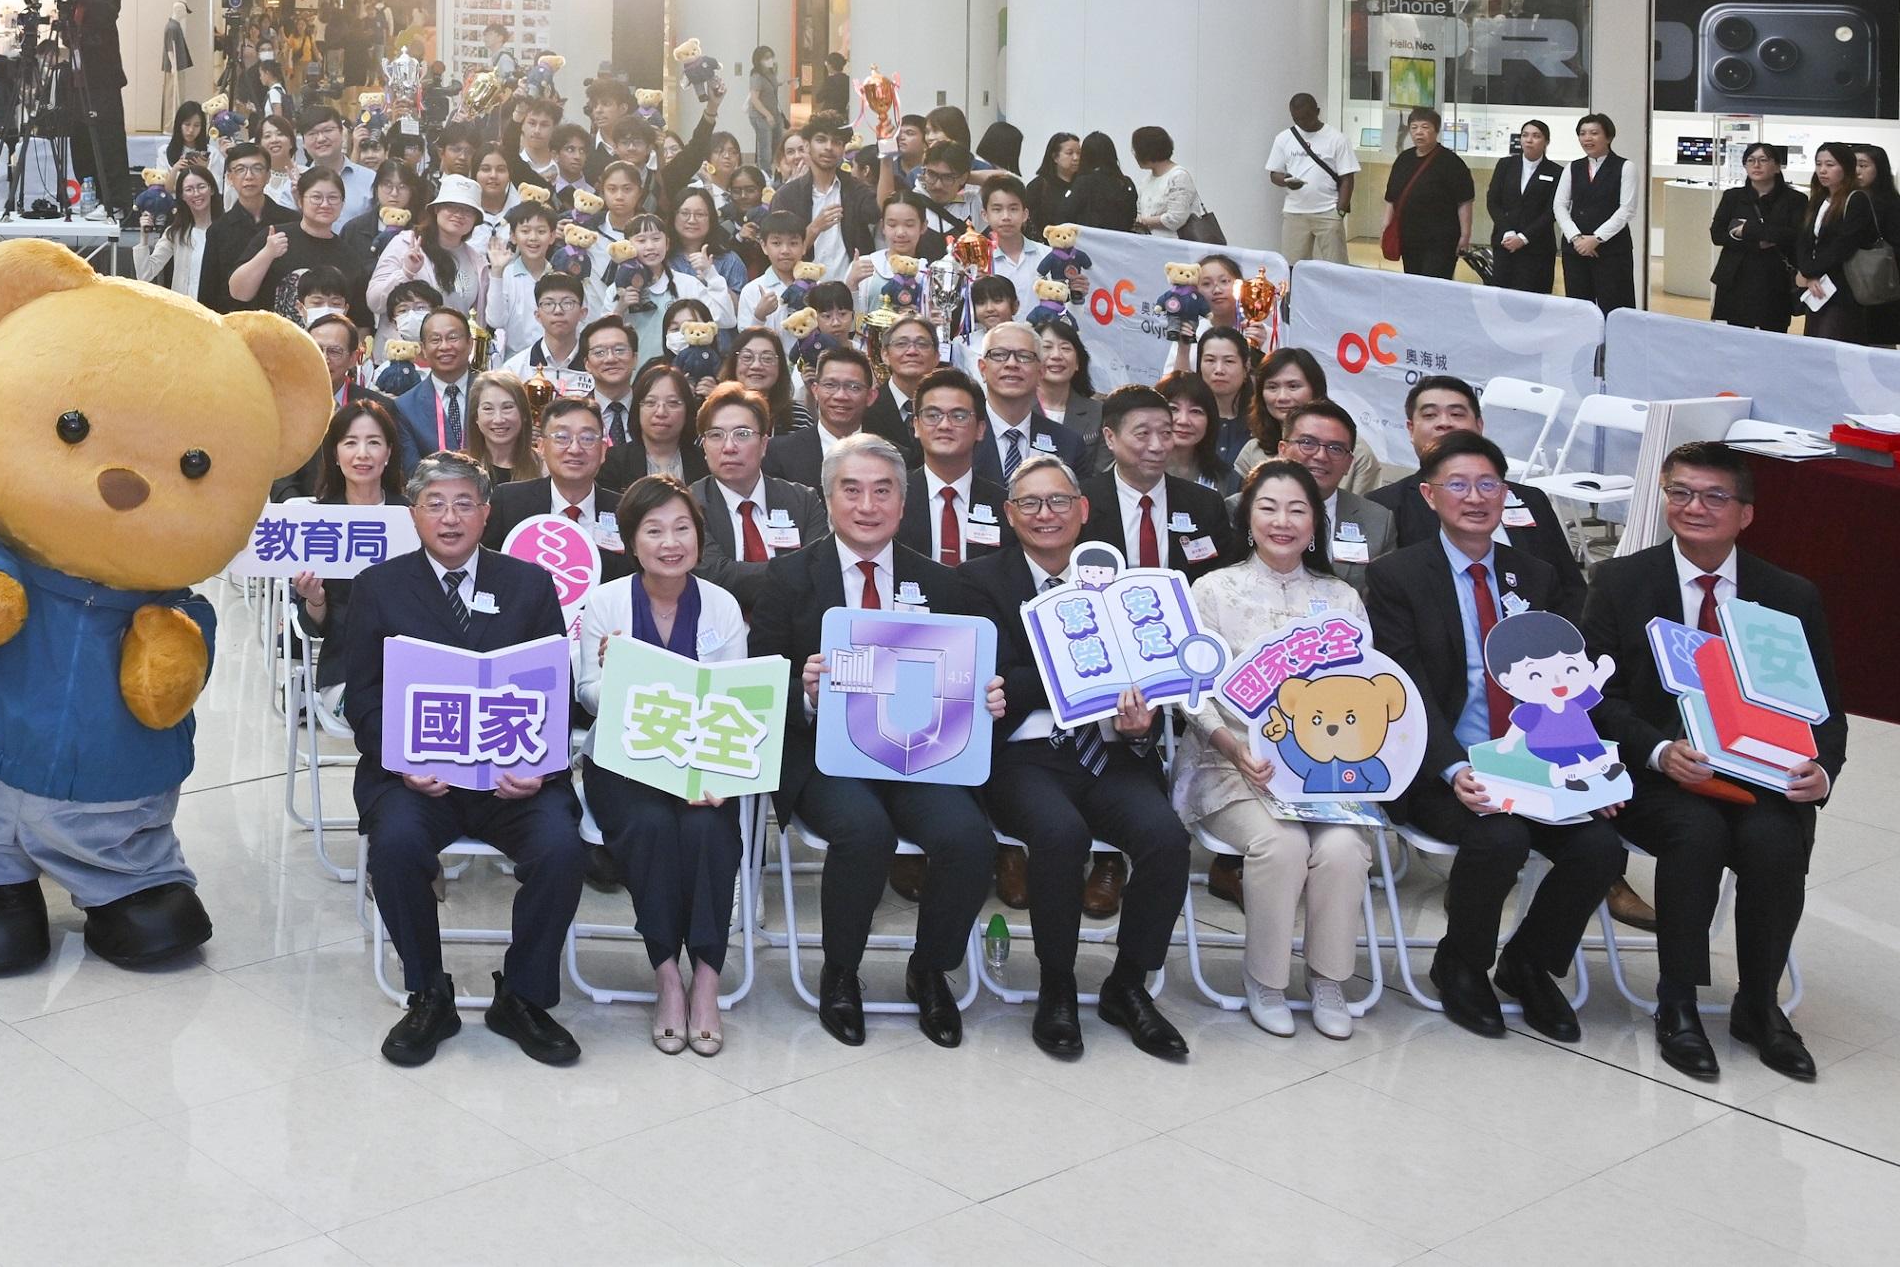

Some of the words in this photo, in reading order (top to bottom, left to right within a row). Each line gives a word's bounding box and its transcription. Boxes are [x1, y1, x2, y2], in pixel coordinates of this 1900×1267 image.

[1389, 38, 1415, 51] Hello,
[1415, 40, 1436, 51] Neo.
[1405, 348, 1448, 372] 奧海城
[255, 517, 388, 564] 教育局
[1056, 597, 1112, 677] 繁榮
[1122, 585, 1178, 662] 安定
[1745, 621, 1811, 690] 安
[947, 670, 971, 685] 4.15
[1224, 619, 1365, 714] 國家安全
[412, 691, 540, 756] 國家
[629, 688, 754, 770] 安全
